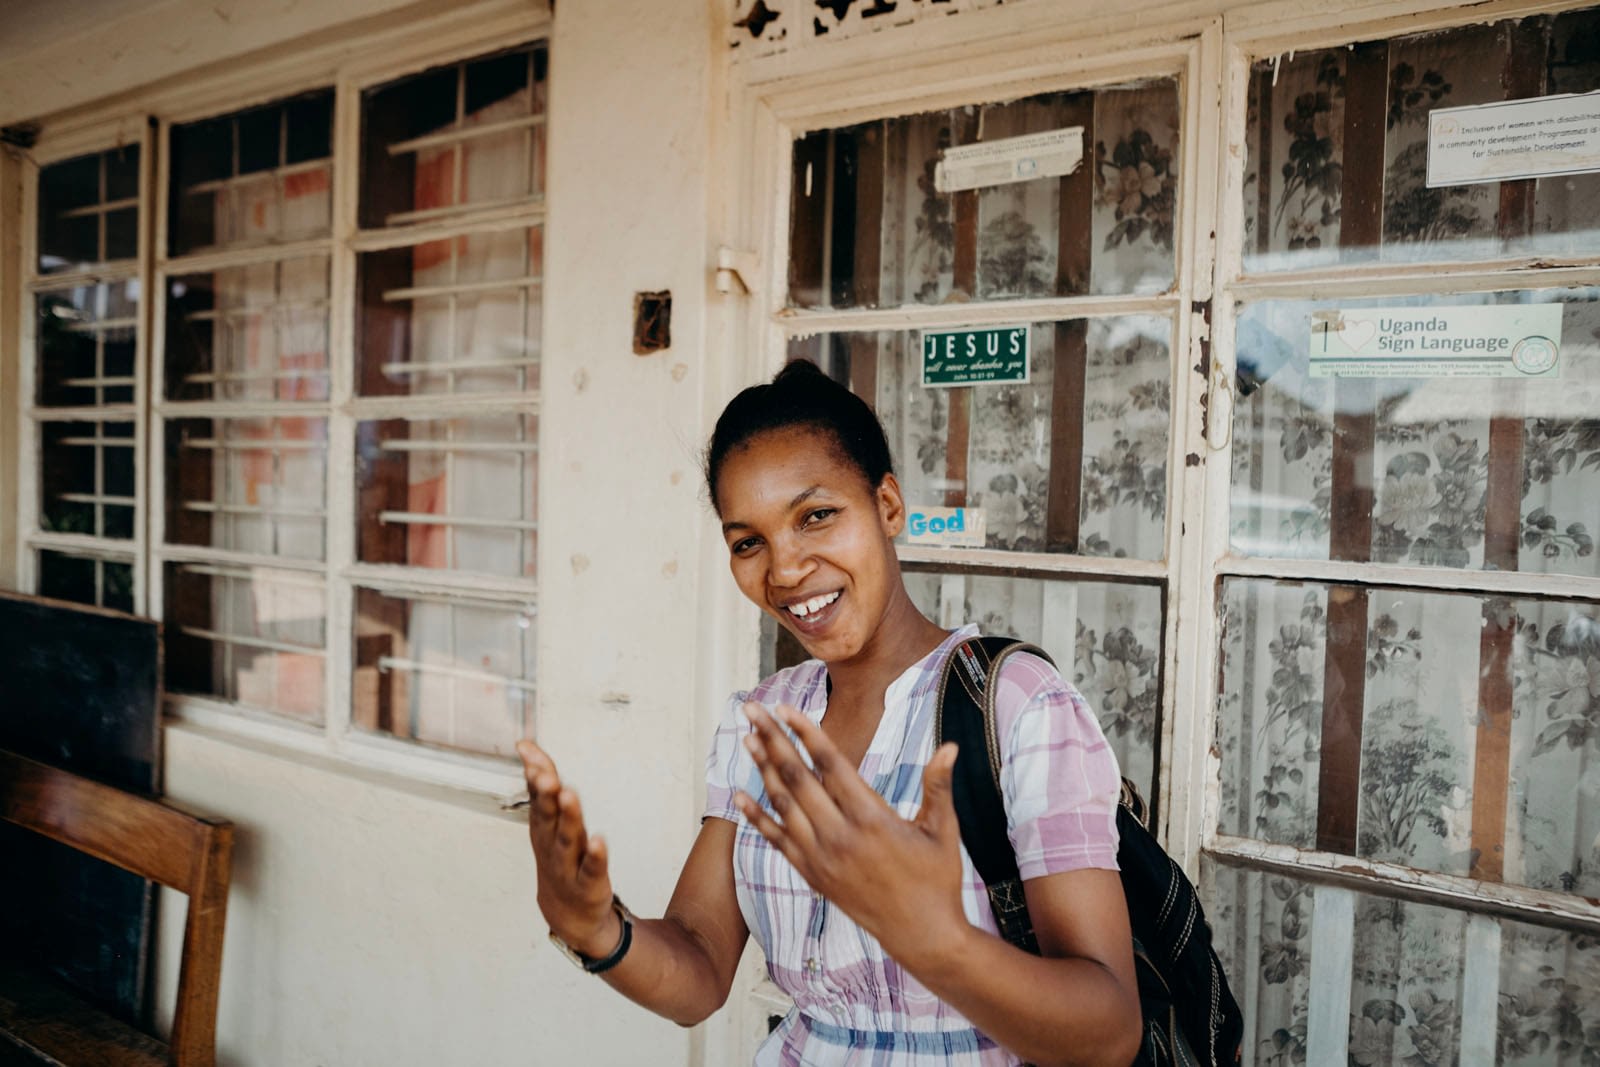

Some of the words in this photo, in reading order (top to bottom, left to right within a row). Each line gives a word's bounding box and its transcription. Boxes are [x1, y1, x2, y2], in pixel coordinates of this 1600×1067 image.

[1461, 125, 1495, 135] Inclusion
[1497, 123, 1506, 131] of
[1508, 120, 1535, 129] women
[1537, 117, 1555, 126] with
[1446, 137, 1485, 149] community
[1487, 132, 1537, 145] development
[1539, 127, 1588, 139] Programmes
[1472, 150, 1485, 158] for
[1487, 145, 1532, 157] Sustainable
[1534, 140, 1586, 152] Development
[1380, 317, 1448, 335] Uganda
[928, 331, 1020, 360] JESUS
[1378, 335, 1415, 352] Sign
[1421, 335, 1509, 353] Language
[909, 507, 965, 536] God
